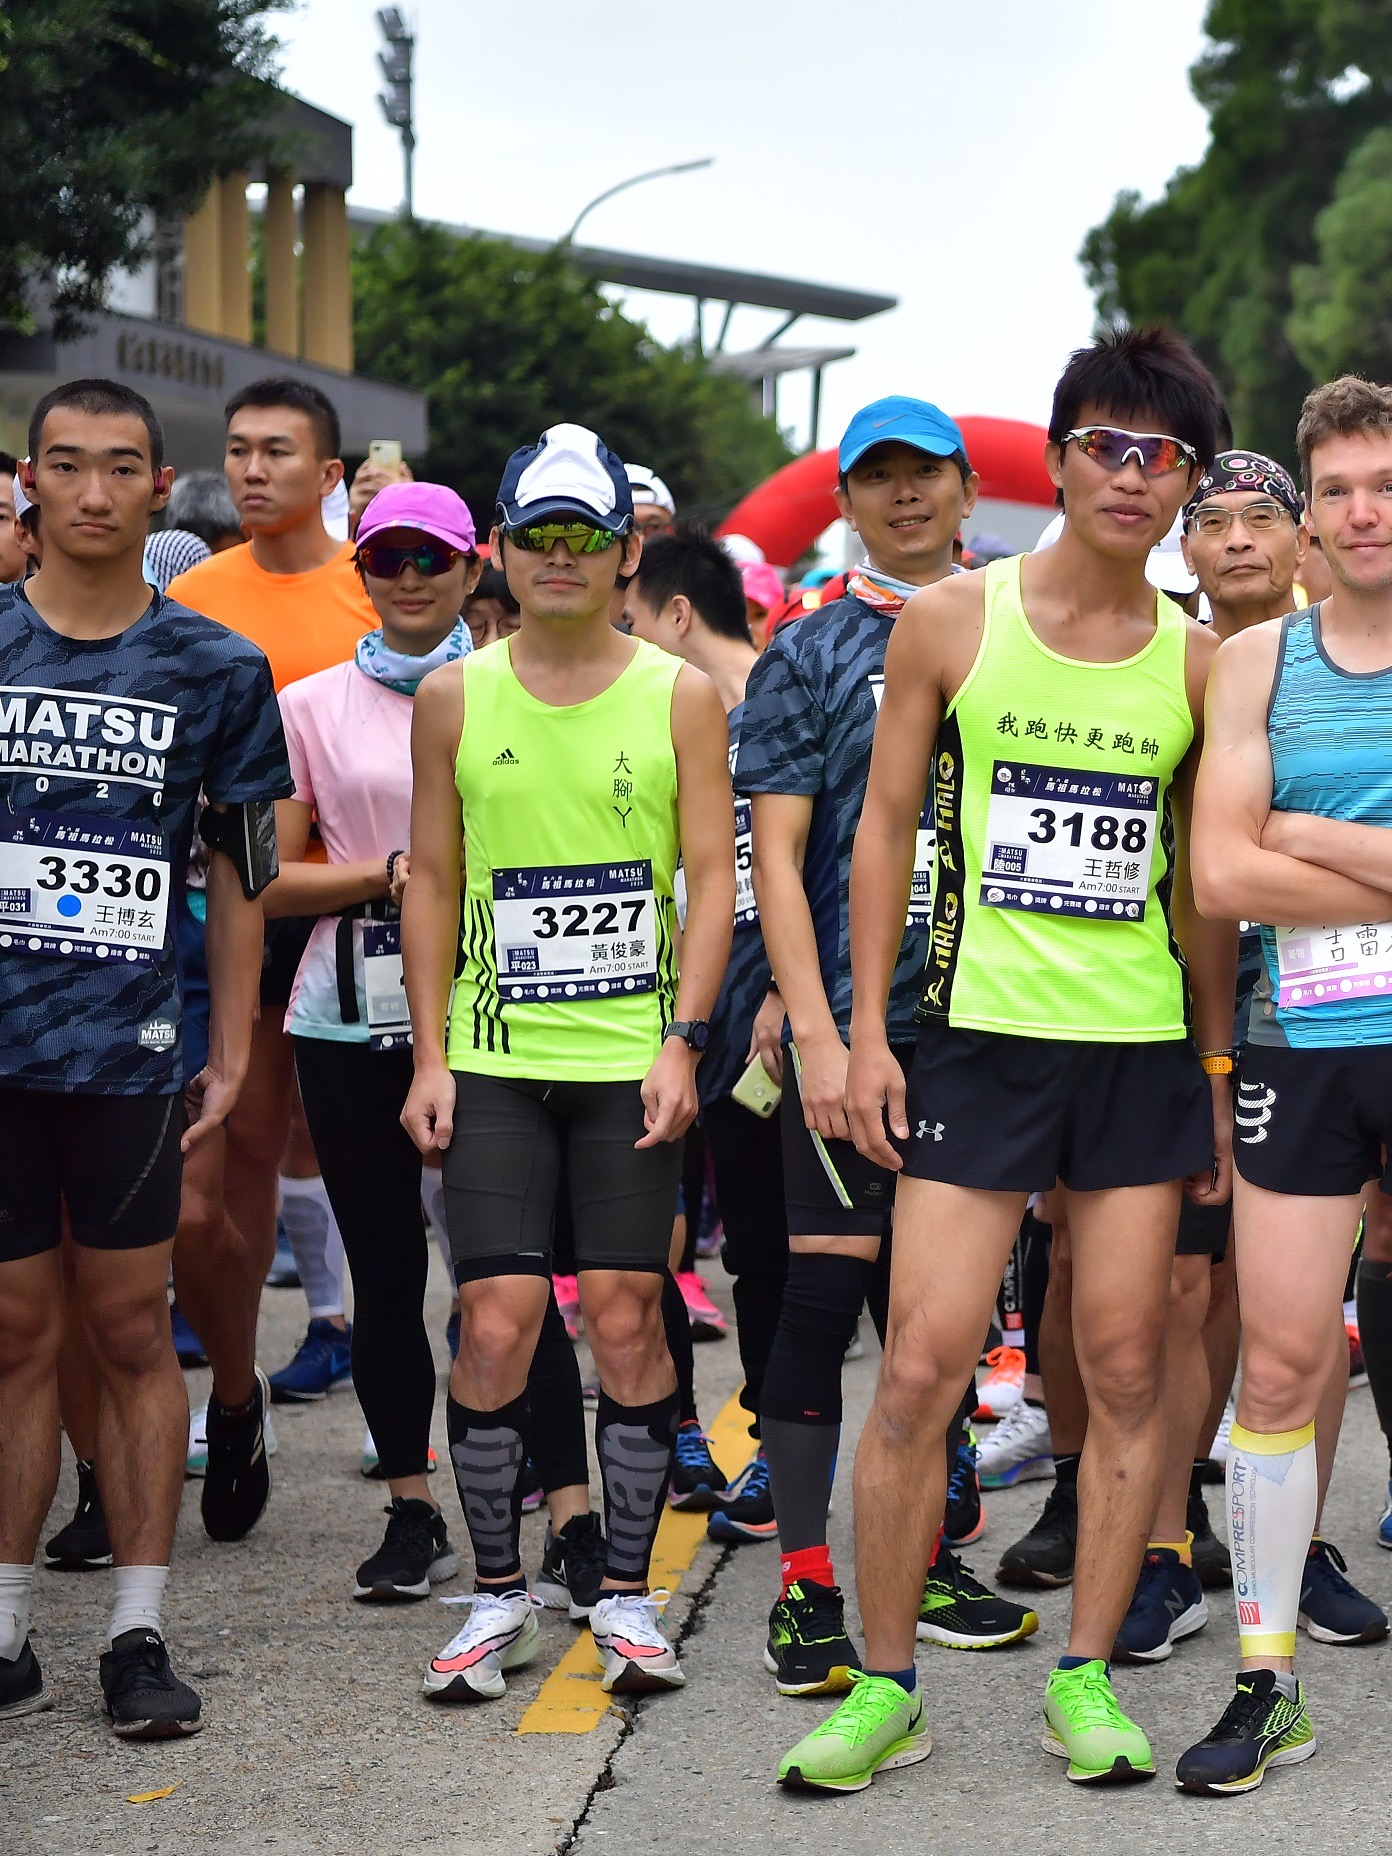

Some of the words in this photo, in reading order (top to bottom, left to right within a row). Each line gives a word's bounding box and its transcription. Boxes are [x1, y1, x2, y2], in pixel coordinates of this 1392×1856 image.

[0, 698, 176, 751] MATSU
[996, 711, 1160, 761] 我跑快更跑帥
[492, 758, 520, 766] adidas
[1044, 781, 1102, 796] 馬祖馬拉松
[1117, 782, 1147, 794] MAT
[54, 830, 115, 846] 馬祖馬拉松
[1028, 808, 1147, 853] 3188
[130, 831, 163, 846] MATSU
[1001, 848, 1022, 856] MATSU
[994, 858, 1021, 872] 陸005
[1083, 858, 1140, 881] 王哲修
[36, 856, 161, 901] 3330
[608, 866, 643, 880] MATSU
[541, 878, 596, 890] 馬祖馬拉松
[1079, 882, 1117, 893] Am7:00
[1119, 886, 1140, 894] START
[94, 904, 156, 929] 王博玄
[532, 899, 646, 939] 3227
[90, 926, 131, 939] Am7:00
[133, 933, 156, 943] START
[590, 939, 646, 962] 黃俊豪
[510, 960, 537, 972] 平023
[589, 963, 626, 975] Am7:00
[628, 961, 650, 971] START
[141, 1029, 175, 1040] MATSU
[1249, 1466, 1258, 1501] TECHNOLOGY
